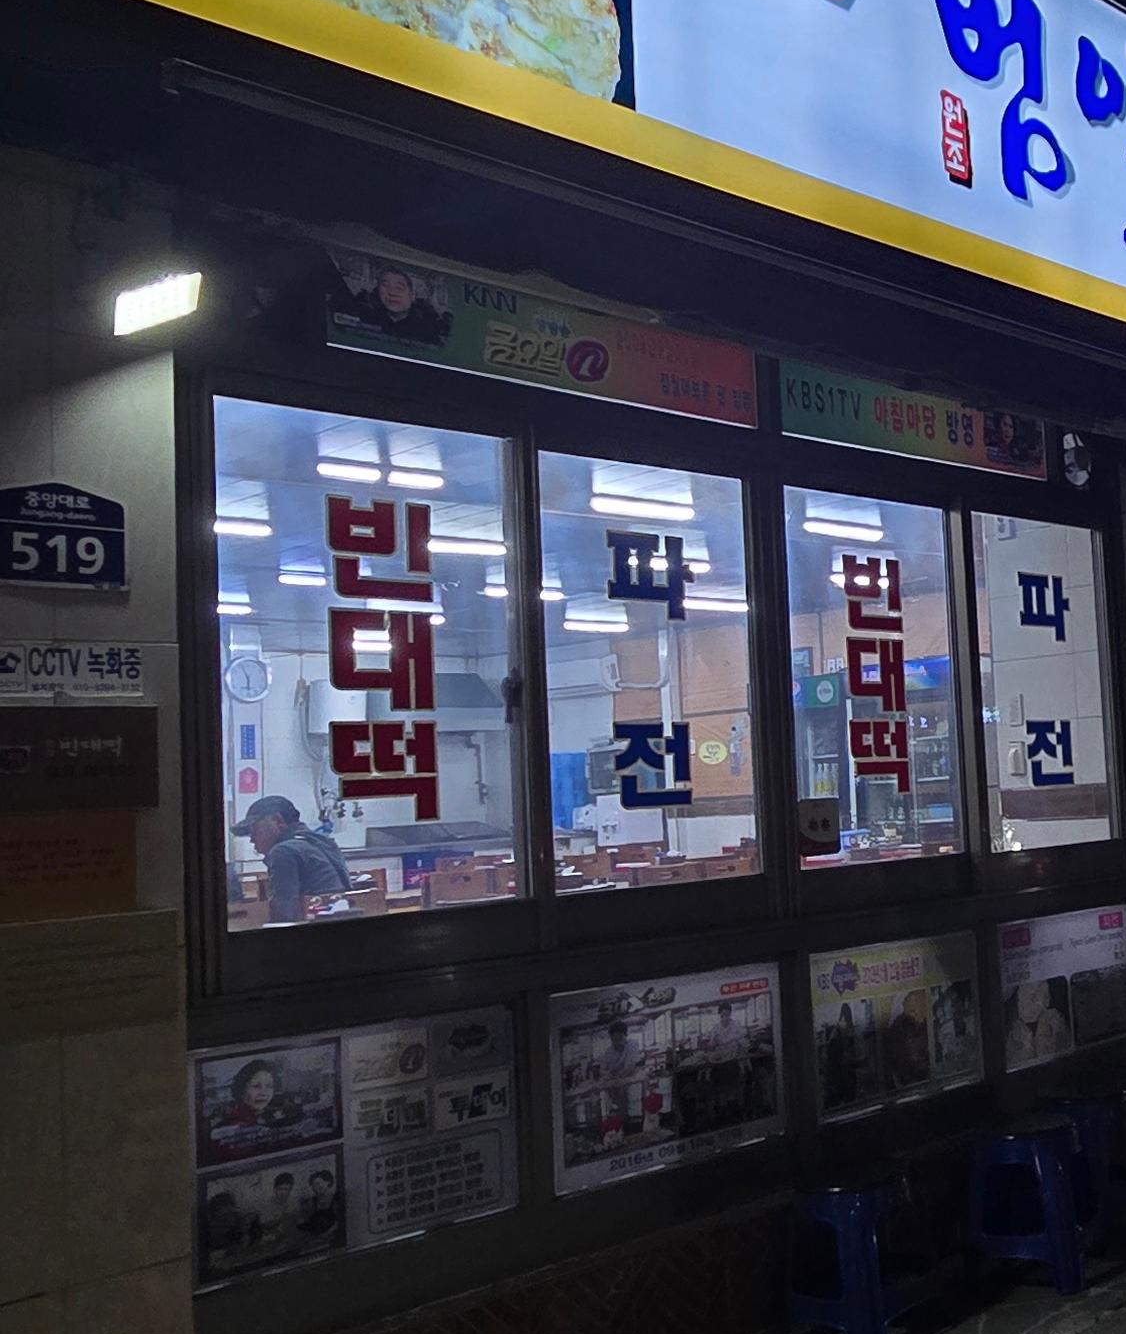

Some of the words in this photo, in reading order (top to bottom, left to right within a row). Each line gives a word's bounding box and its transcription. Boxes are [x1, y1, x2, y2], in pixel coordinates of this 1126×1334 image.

[943, 95, 966, 173] 원조
[463, 282, 518, 316] KNN
[785, 377, 862, 420] KBS1TV
[873, 395, 937, 441] 아침마당
[945, 409, 975, 448] 방영
[23, 490, 92, 510] 중앙대로
[11, 530, 106, 575] 519
[28, 646, 81, 677] CCTV
[87, 646, 142, 680] 녹화중
[325, 493, 441, 822] 빈대떡
[842, 553, 911, 795] 빈대떡
